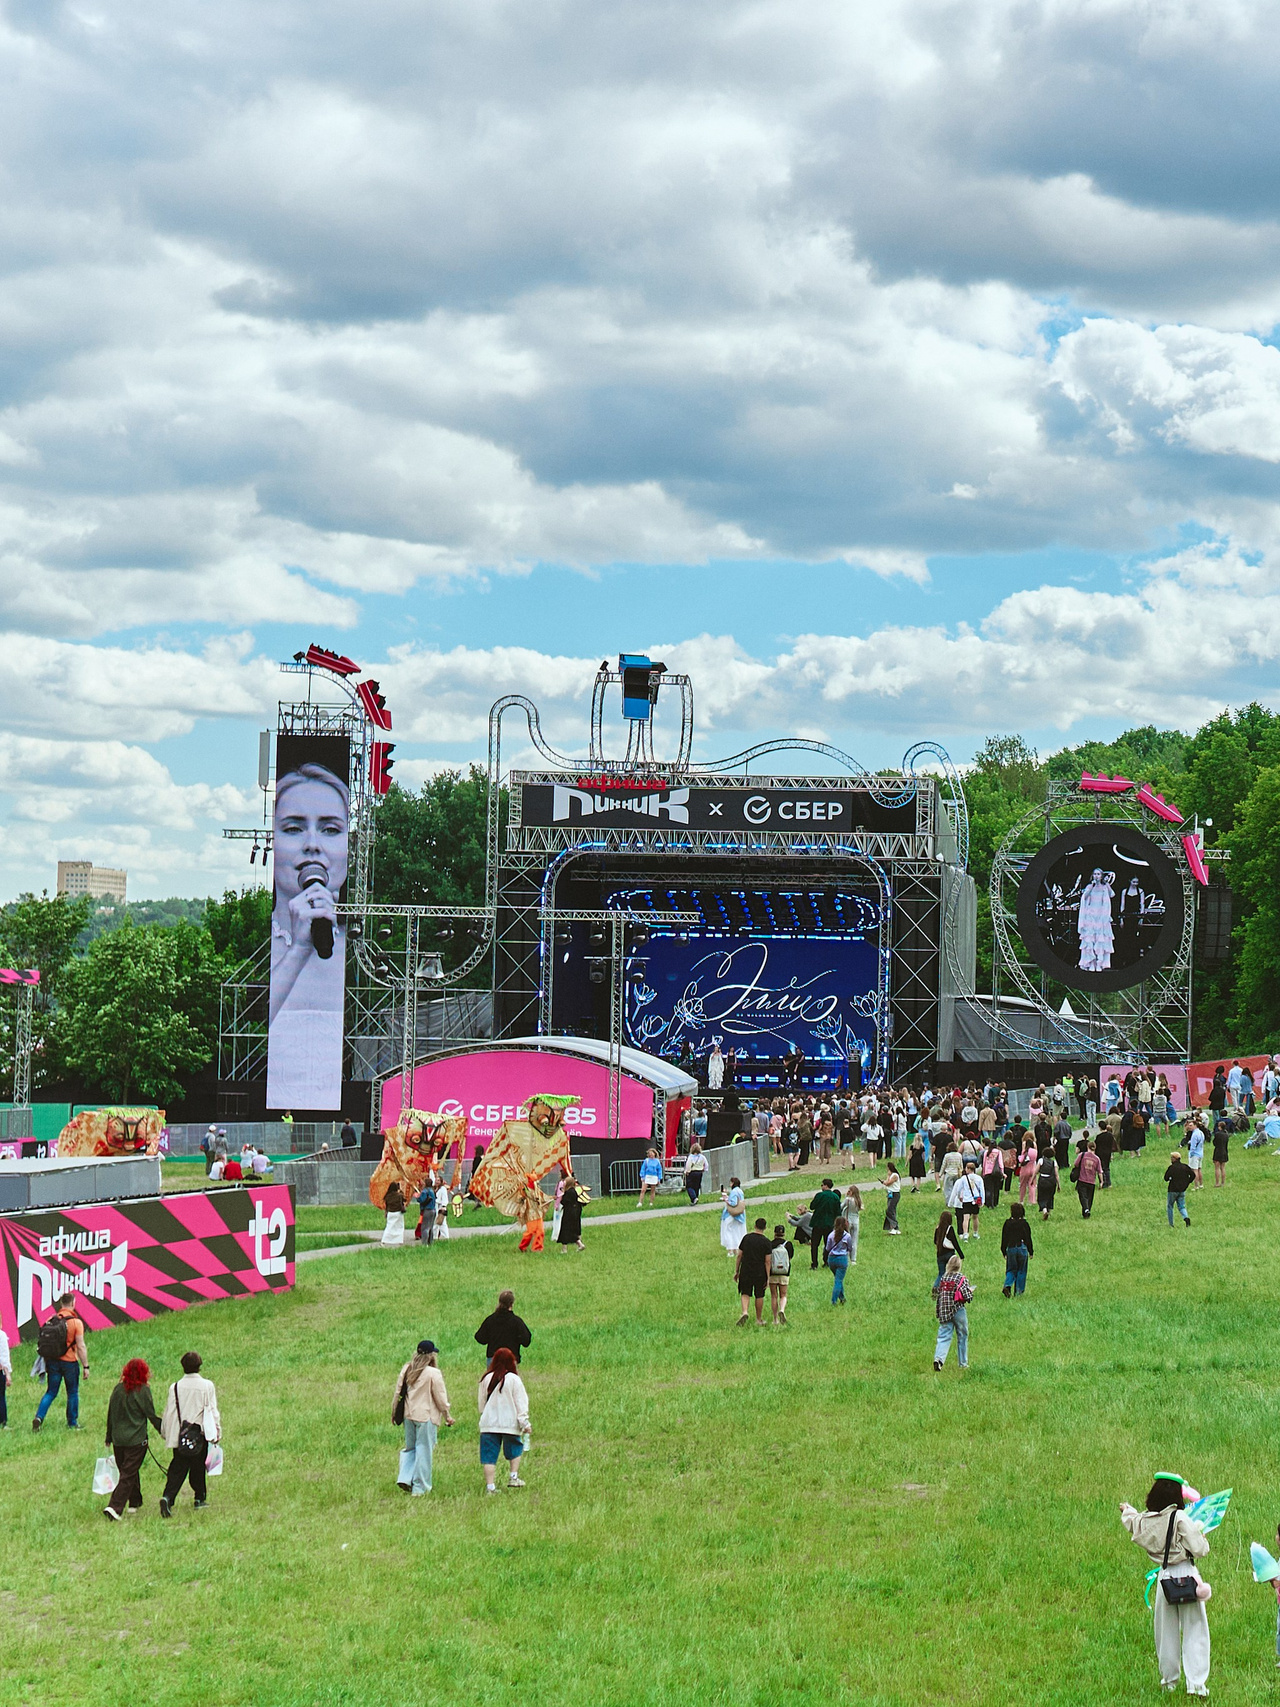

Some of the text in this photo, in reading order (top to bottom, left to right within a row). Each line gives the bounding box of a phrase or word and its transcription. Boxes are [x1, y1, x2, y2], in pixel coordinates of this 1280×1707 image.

[578, 774, 666, 792] афиша
[778, 801, 844, 820] СБЕР
[39, 1226, 111, 1261] афиша
[249, 1200, 287, 1276] t2
